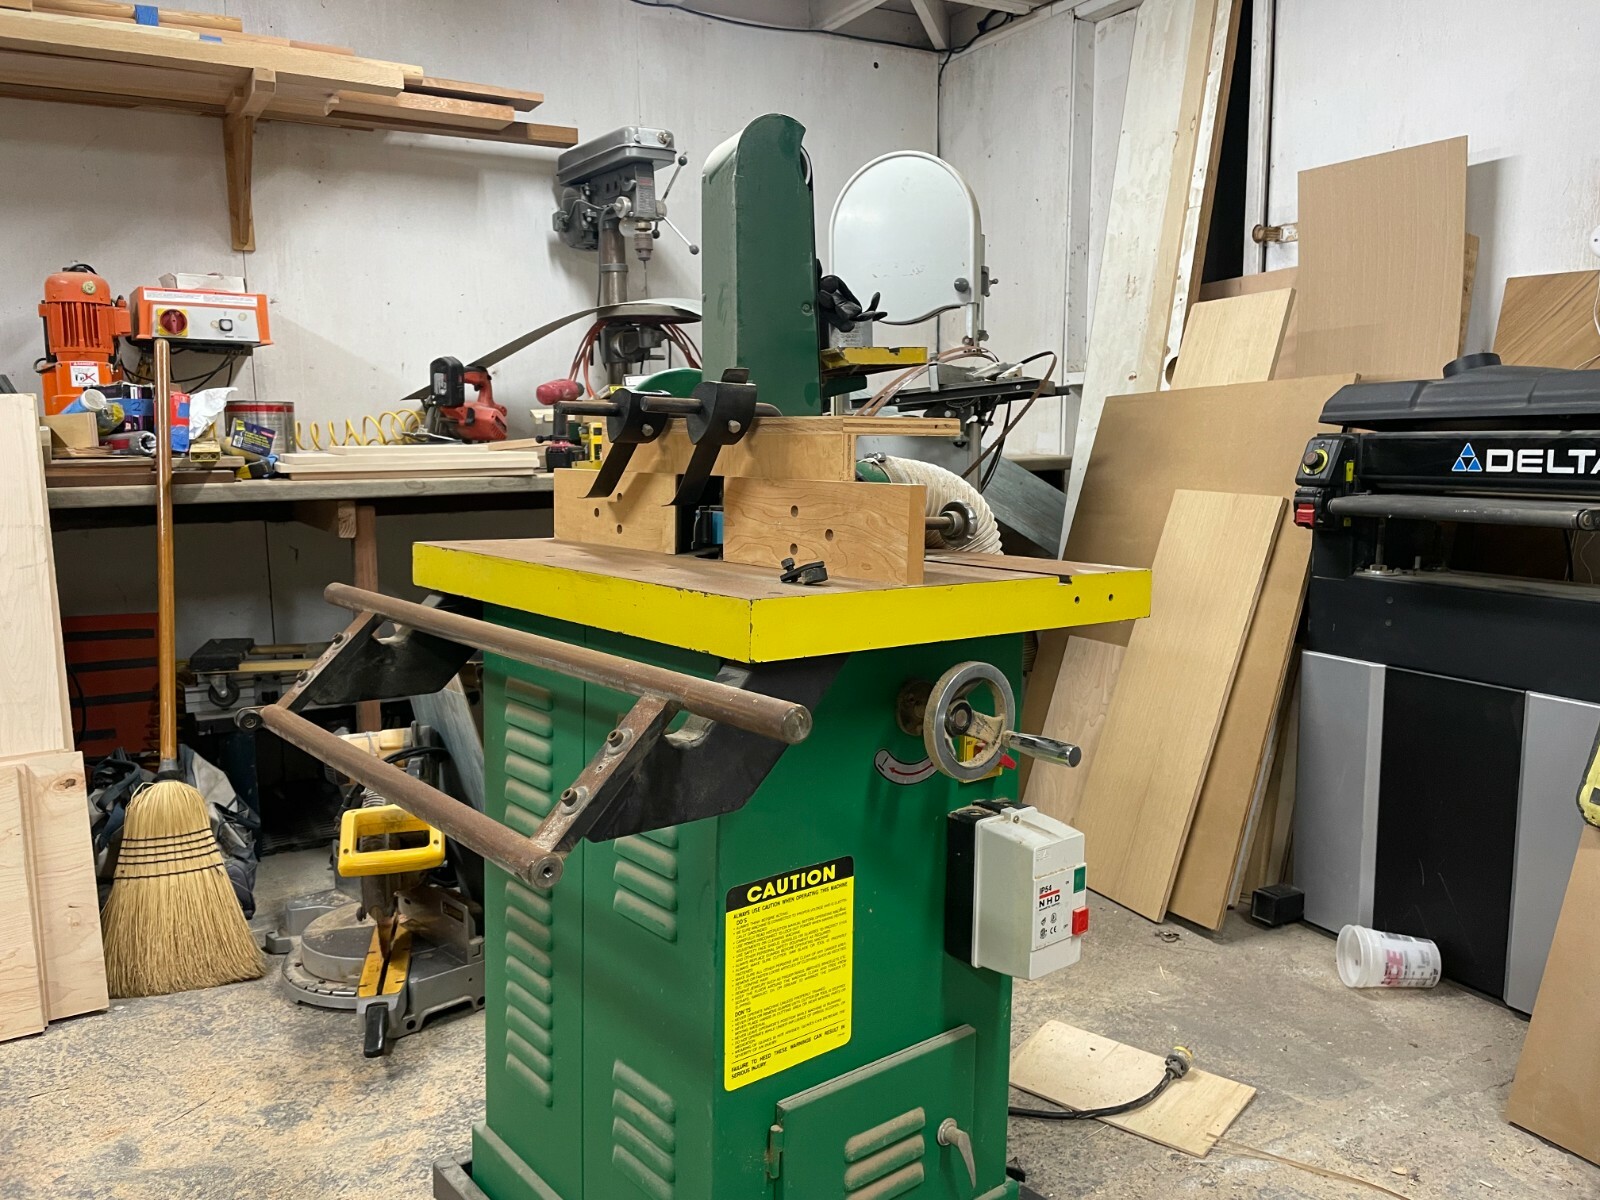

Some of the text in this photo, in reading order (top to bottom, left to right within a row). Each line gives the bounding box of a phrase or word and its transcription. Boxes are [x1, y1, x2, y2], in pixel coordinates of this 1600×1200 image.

[746, 864, 836, 902] CAUTION
[761, 901, 780, 910] CAUTION
[795, 890, 818, 900] OPERATING
[1038, 894, 1060, 908] NHD
[731, 1062, 748, 1072] FAILURE
